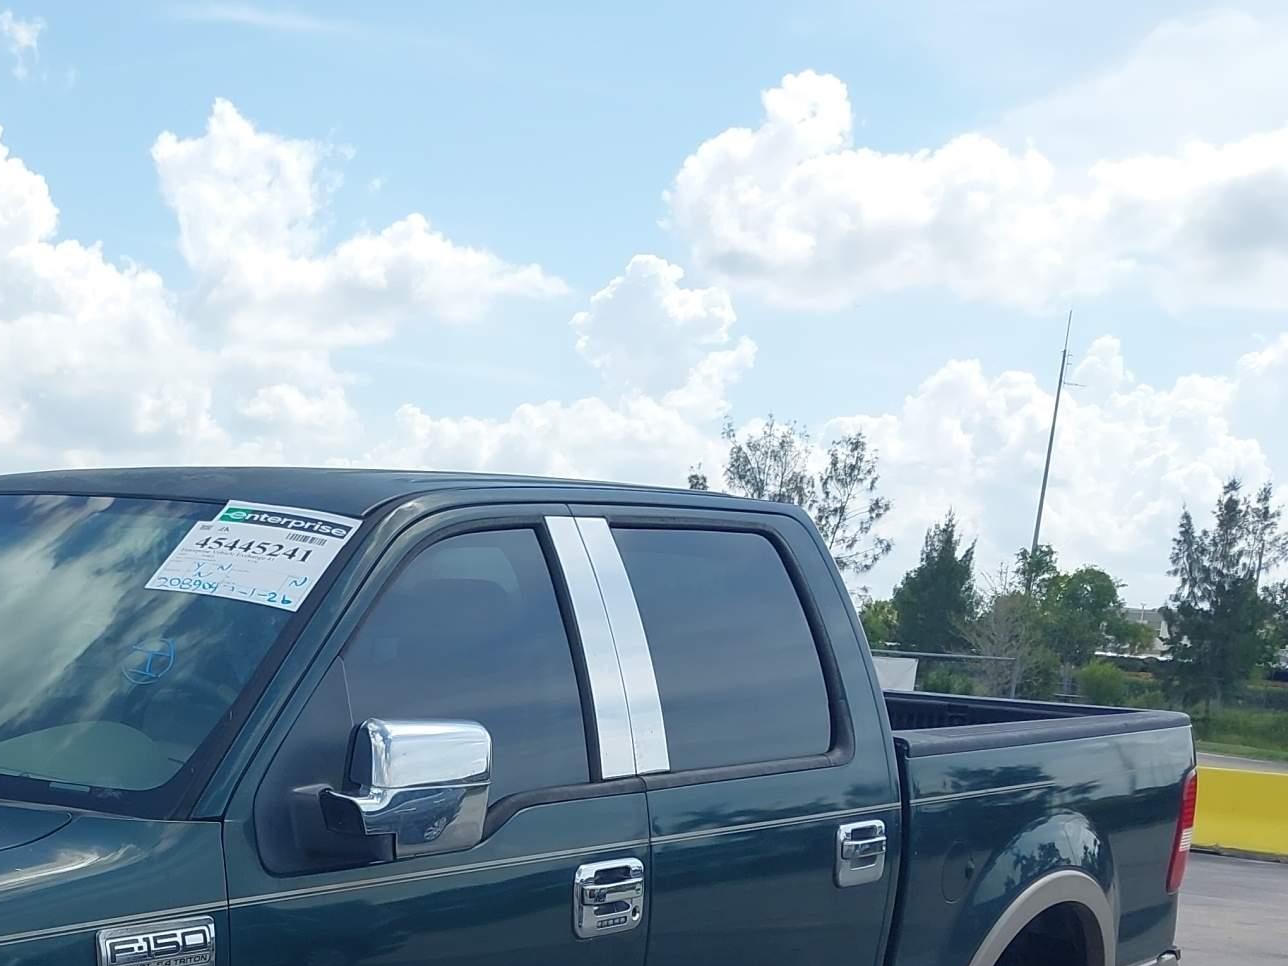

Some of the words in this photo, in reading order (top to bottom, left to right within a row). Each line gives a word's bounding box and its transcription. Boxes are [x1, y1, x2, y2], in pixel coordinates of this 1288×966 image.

[223, 509, 348, 537] enterprise
[195, 535, 313, 563] 45445241
[175, 954, 208, 965] TRITON
